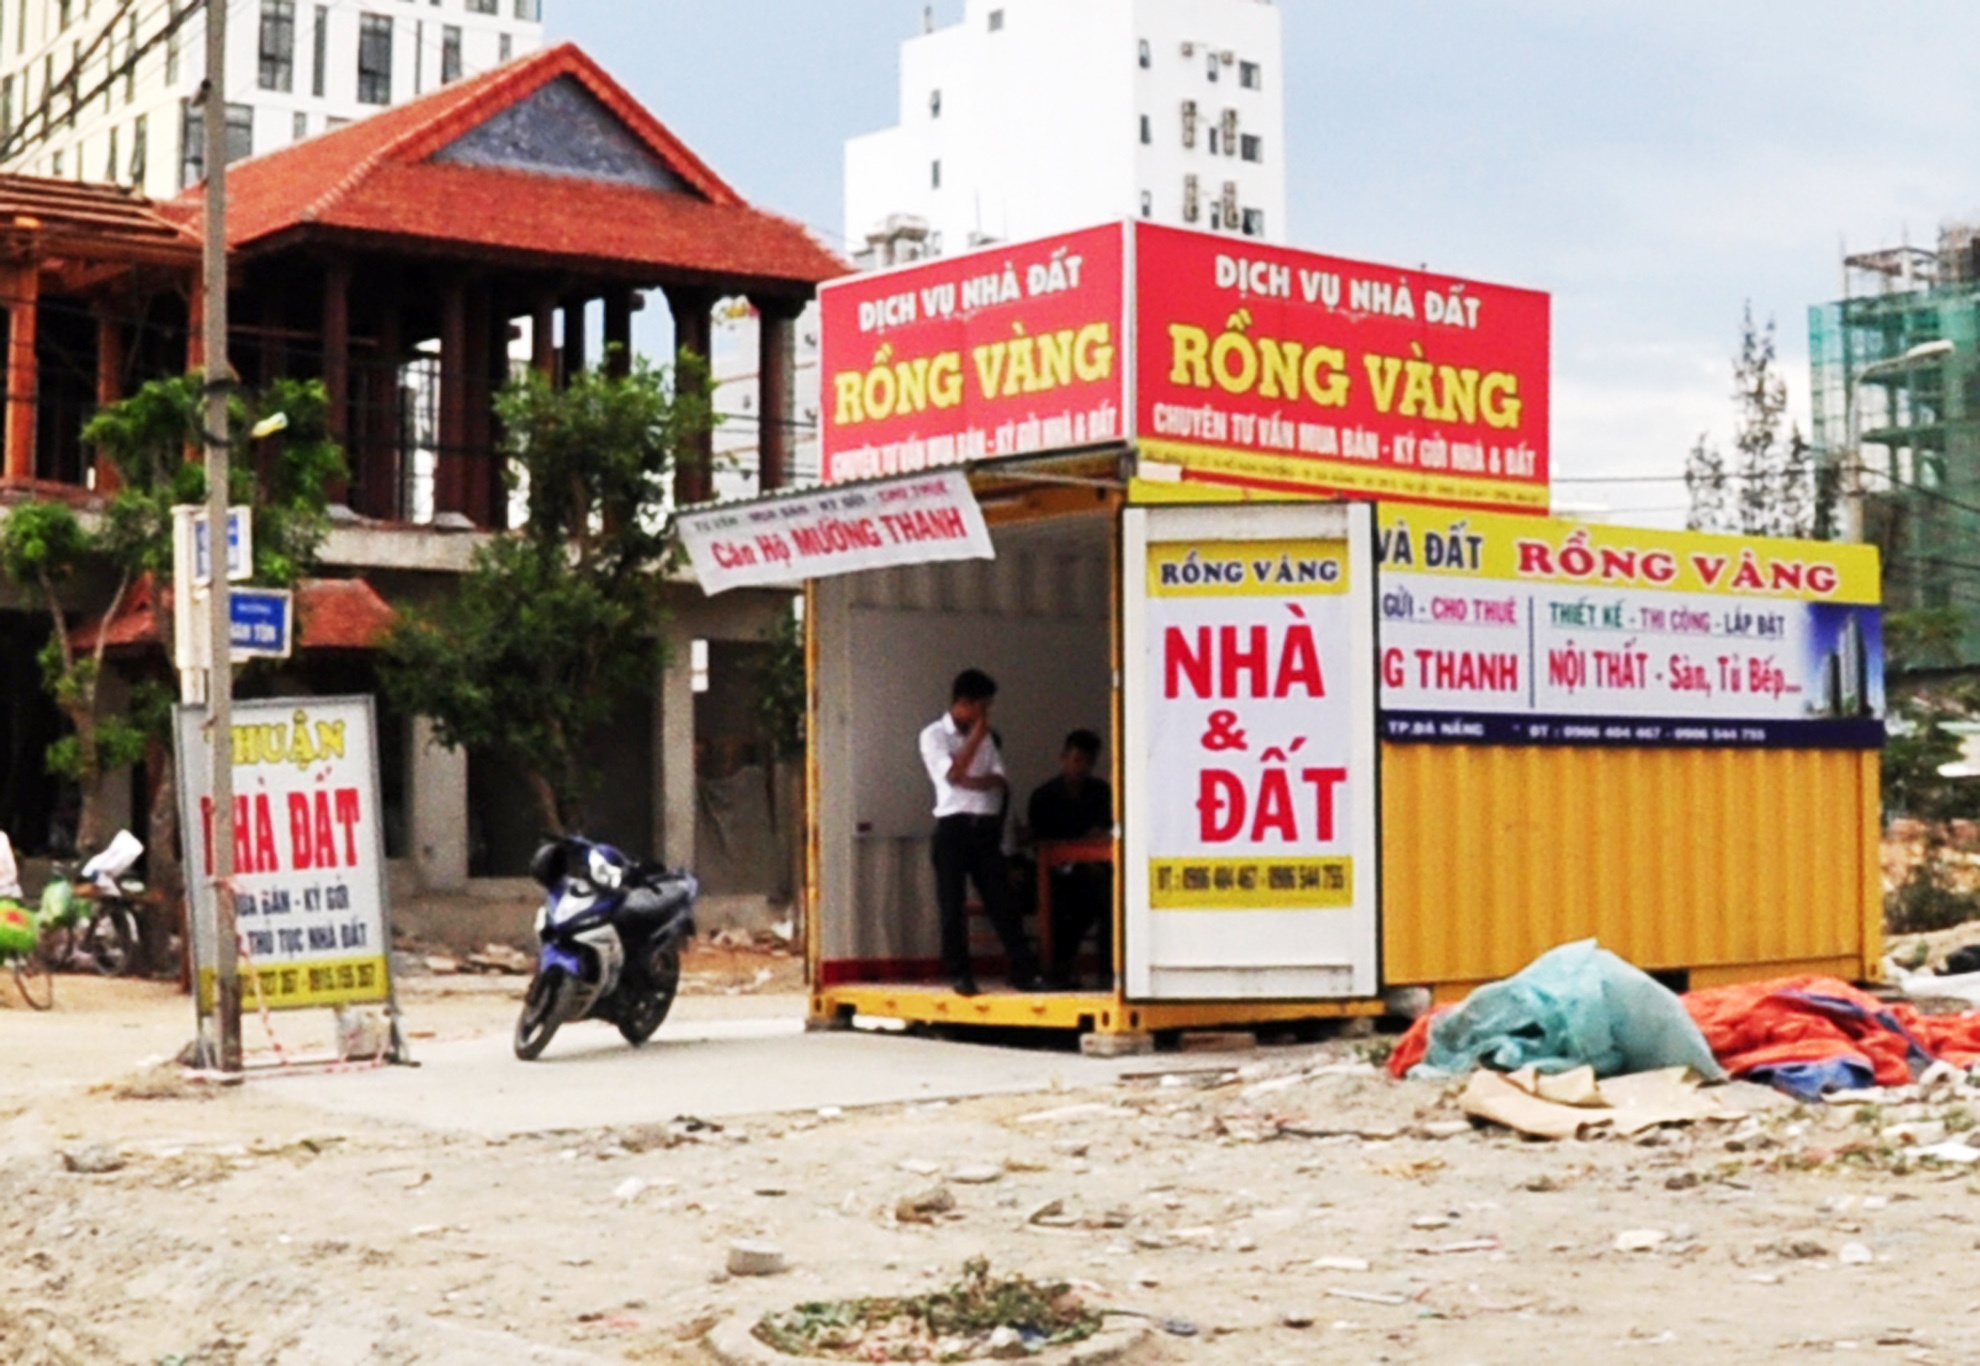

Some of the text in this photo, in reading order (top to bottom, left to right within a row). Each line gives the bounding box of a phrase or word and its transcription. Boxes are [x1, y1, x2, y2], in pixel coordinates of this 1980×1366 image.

[859, 246, 1083, 334] DỊCH VỤ NHÀ ĐẤT
[1215, 254, 1481, 329] DỊCH VỤ NHÀ ĐẤT
[834, 321, 1114, 425] RỒNG VÀNG
[1168, 308, 1522, 429] RỒNG VÀNG
[879, 506, 968, 544] THANH
[1424, 521, 1483, 569] ĐẤT
[1517, 530, 1675, 582] RỒNG
[1692, 551, 1837, 593] VÀNG
[1431, 596, 1467, 621] CHO
[1473, 596, 1517, 625] THUÊ
[1640, 607, 1665, 629] THI
[1164, 602, 1325, 699] NHÀ
[1381, 647, 1518, 692] G THANH
[1548, 639, 1586, 694] NỘI
[1593, 637, 1648, 689] THẤT
[204, 709, 346, 771] HUẬN
[1200, 710, 1249, 752] &
[287, 766, 360, 870] ĐẤT
[1196, 736, 1347, 843] ĐẤT
[234, 893, 257, 916] UA
